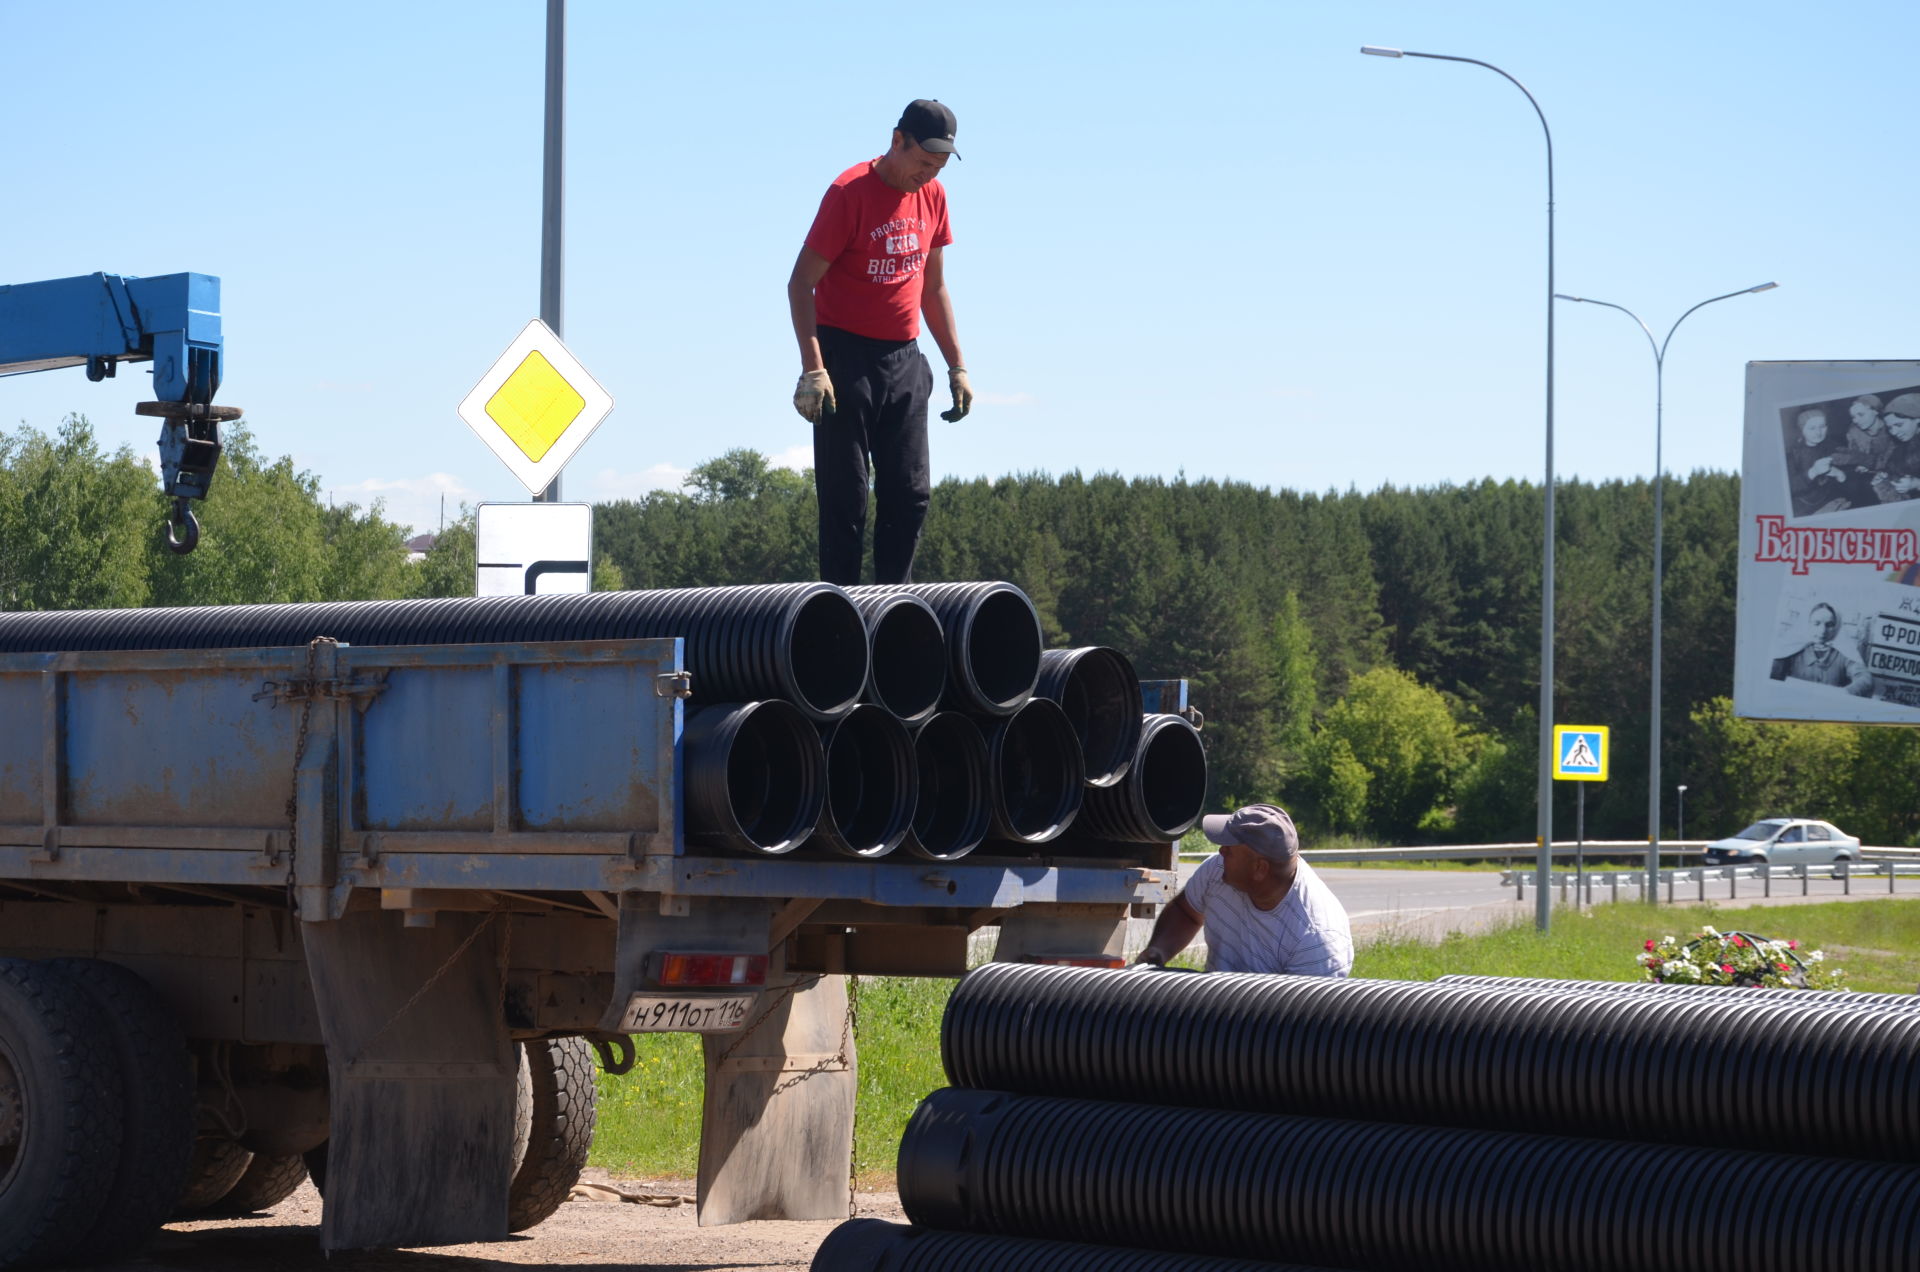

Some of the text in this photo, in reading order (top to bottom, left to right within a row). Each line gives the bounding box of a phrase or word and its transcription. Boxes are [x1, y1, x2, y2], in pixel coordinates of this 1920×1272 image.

[870, 217, 916, 240] PROPERTY
[867, 258, 896, 274] BIG
[1881, 623, 1920, 645] ФРО
[719, 1000, 745, 1020] 116
